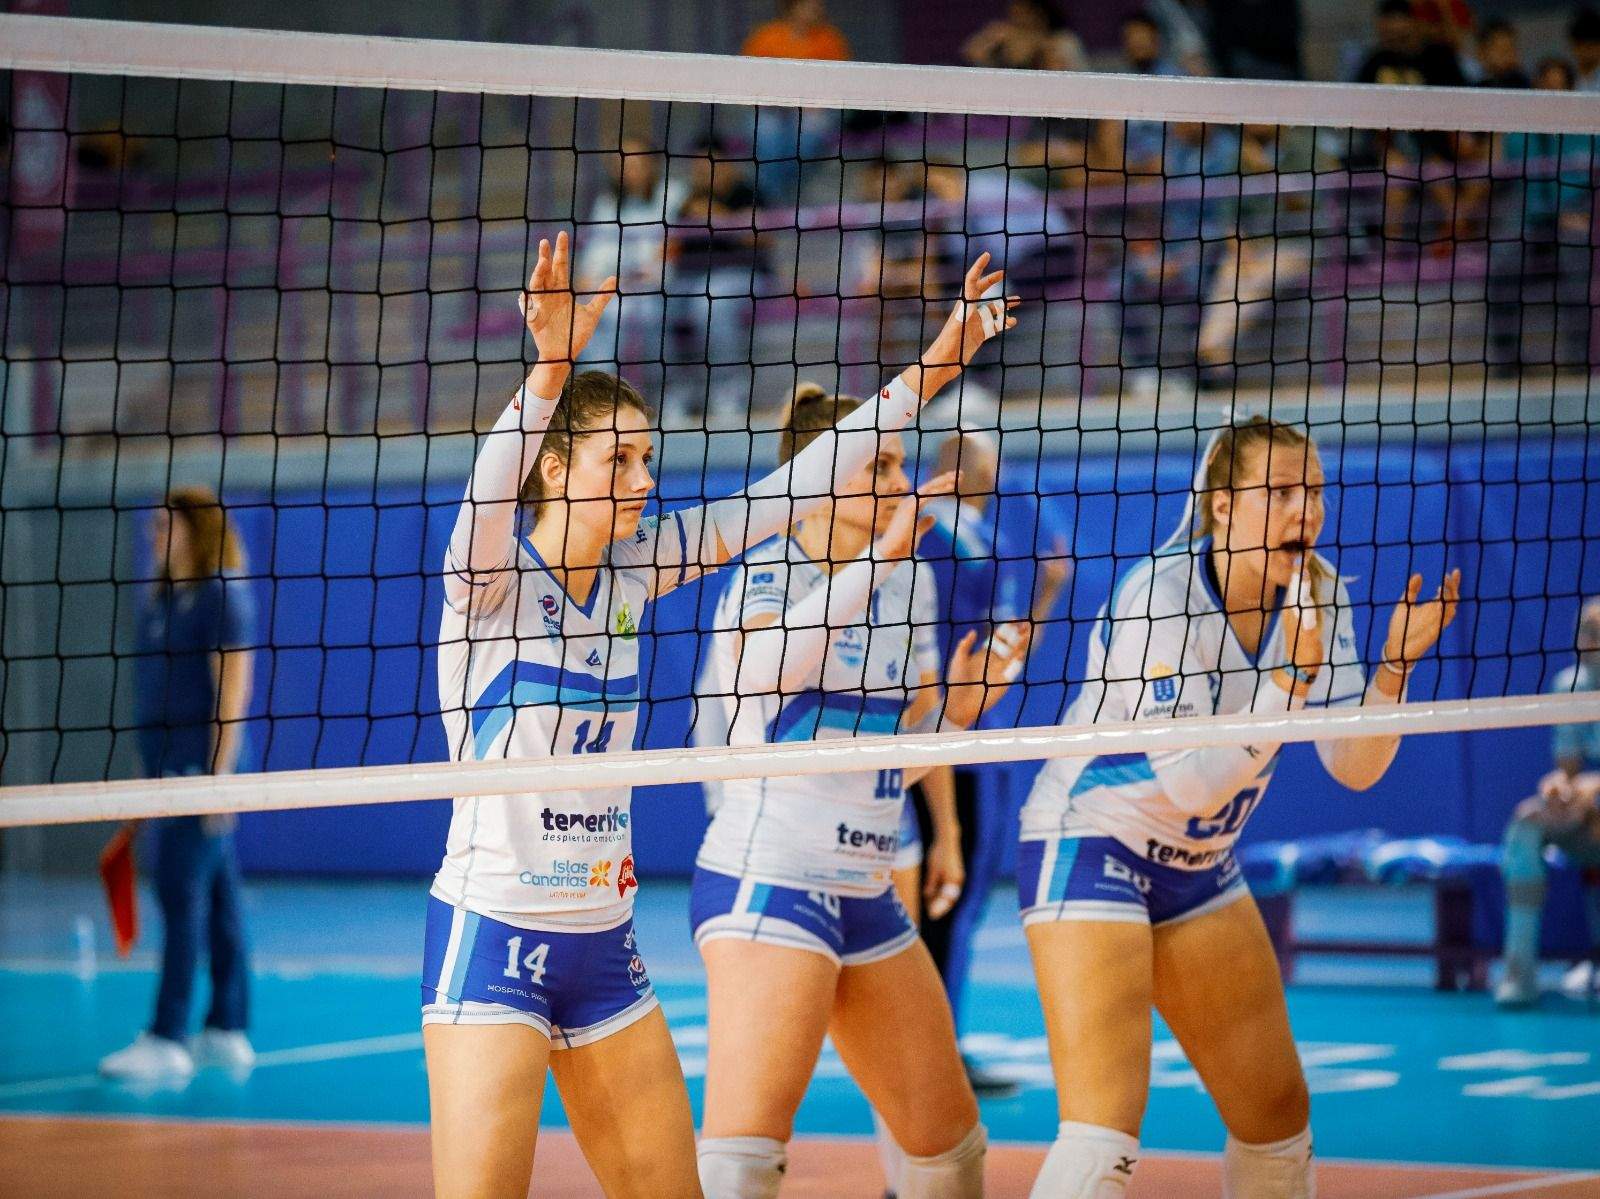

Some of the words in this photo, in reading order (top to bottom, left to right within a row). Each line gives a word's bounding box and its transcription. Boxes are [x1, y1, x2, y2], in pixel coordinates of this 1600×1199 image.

[541, 806, 629, 832] tenerife
[543, 833, 591, 842] despierta
[553, 859, 589, 874] Islas
[519, 871, 588, 887] Canarias
[503, 935, 550, 986] 14
[487, 984, 530, 998] HOSPITAL
